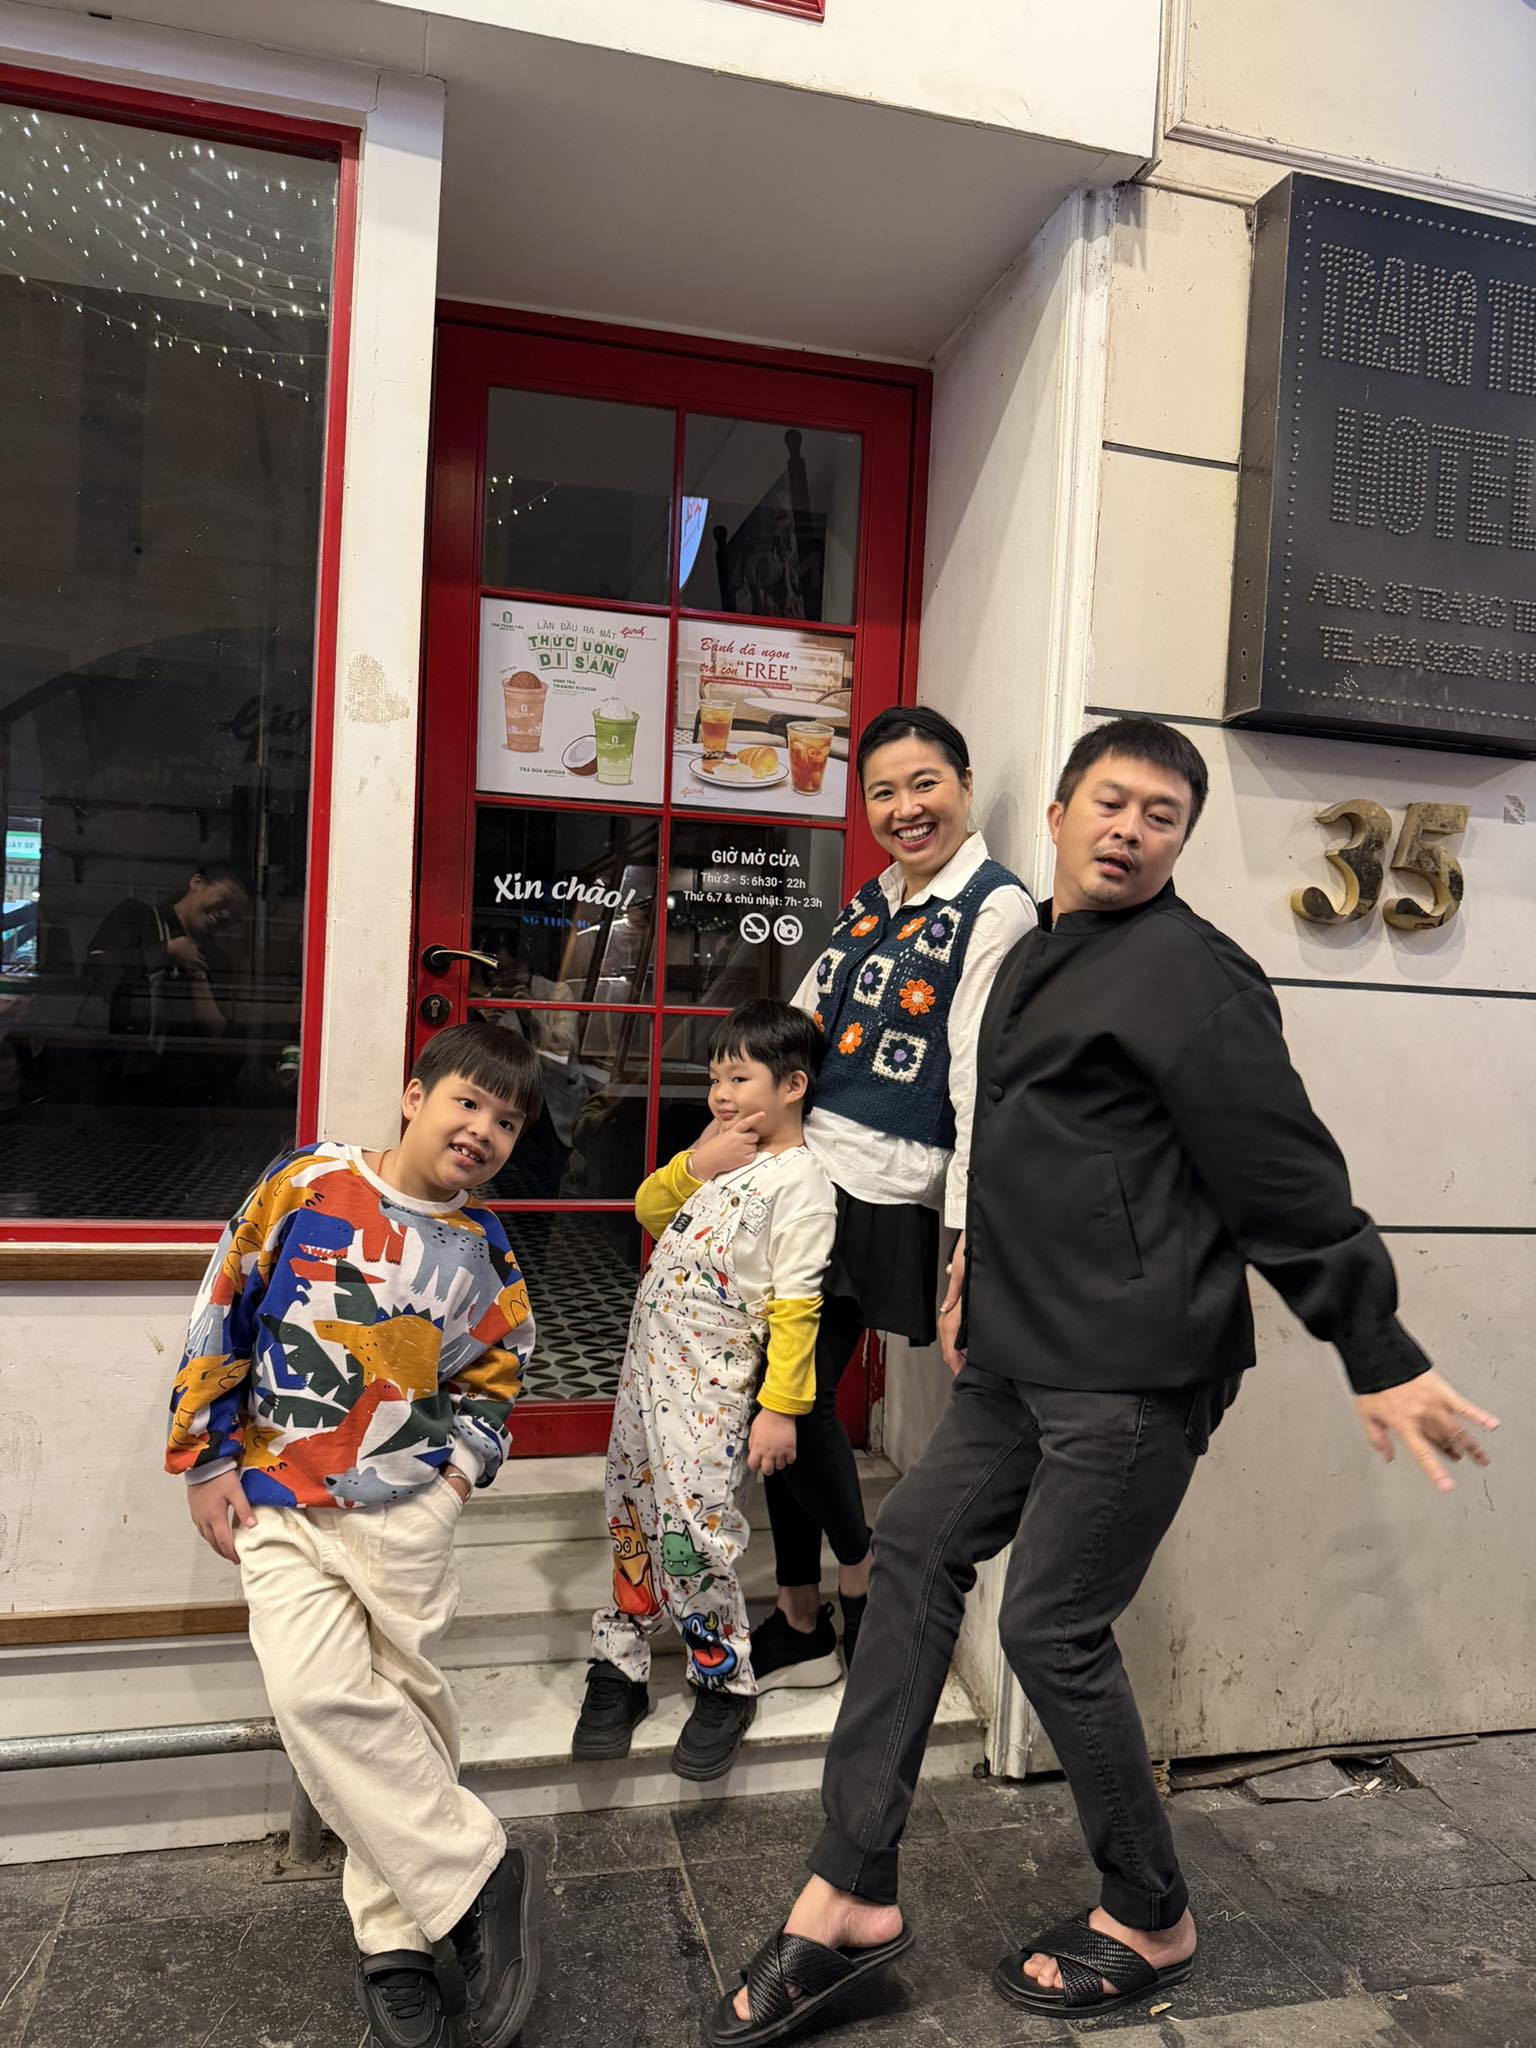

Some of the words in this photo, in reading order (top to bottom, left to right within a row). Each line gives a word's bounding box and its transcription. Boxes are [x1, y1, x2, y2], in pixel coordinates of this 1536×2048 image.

[1318, 242, 1477, 387] TRANG
[1329, 406, 1536, 552] HOTEL
[583, 625, 595, 635] RA
[539, 652, 562, 667] DI
[700, 637, 735, 655] Bánh
[761, 649, 791, 662] ngon
[711, 846, 738, 865] GIỜ
[741, 848, 766, 866] MỞ
[769, 848, 801, 868] CỬA
[1290, 798, 1472, 931] 35
[493, 872, 545, 904] Xin
[551, 876, 637, 911] chào!
[701, 872, 722, 883] Thứ
[723, 874, 730, 884] 2
[786, 879, 806, 889] 22h
[683, 890, 705, 902] Thứ
[706, 892, 722, 903] 6,7
[725, 893, 733, 903] &
[734, 893, 754, 905] chủ
[803, 898, 823, 908] 23h
